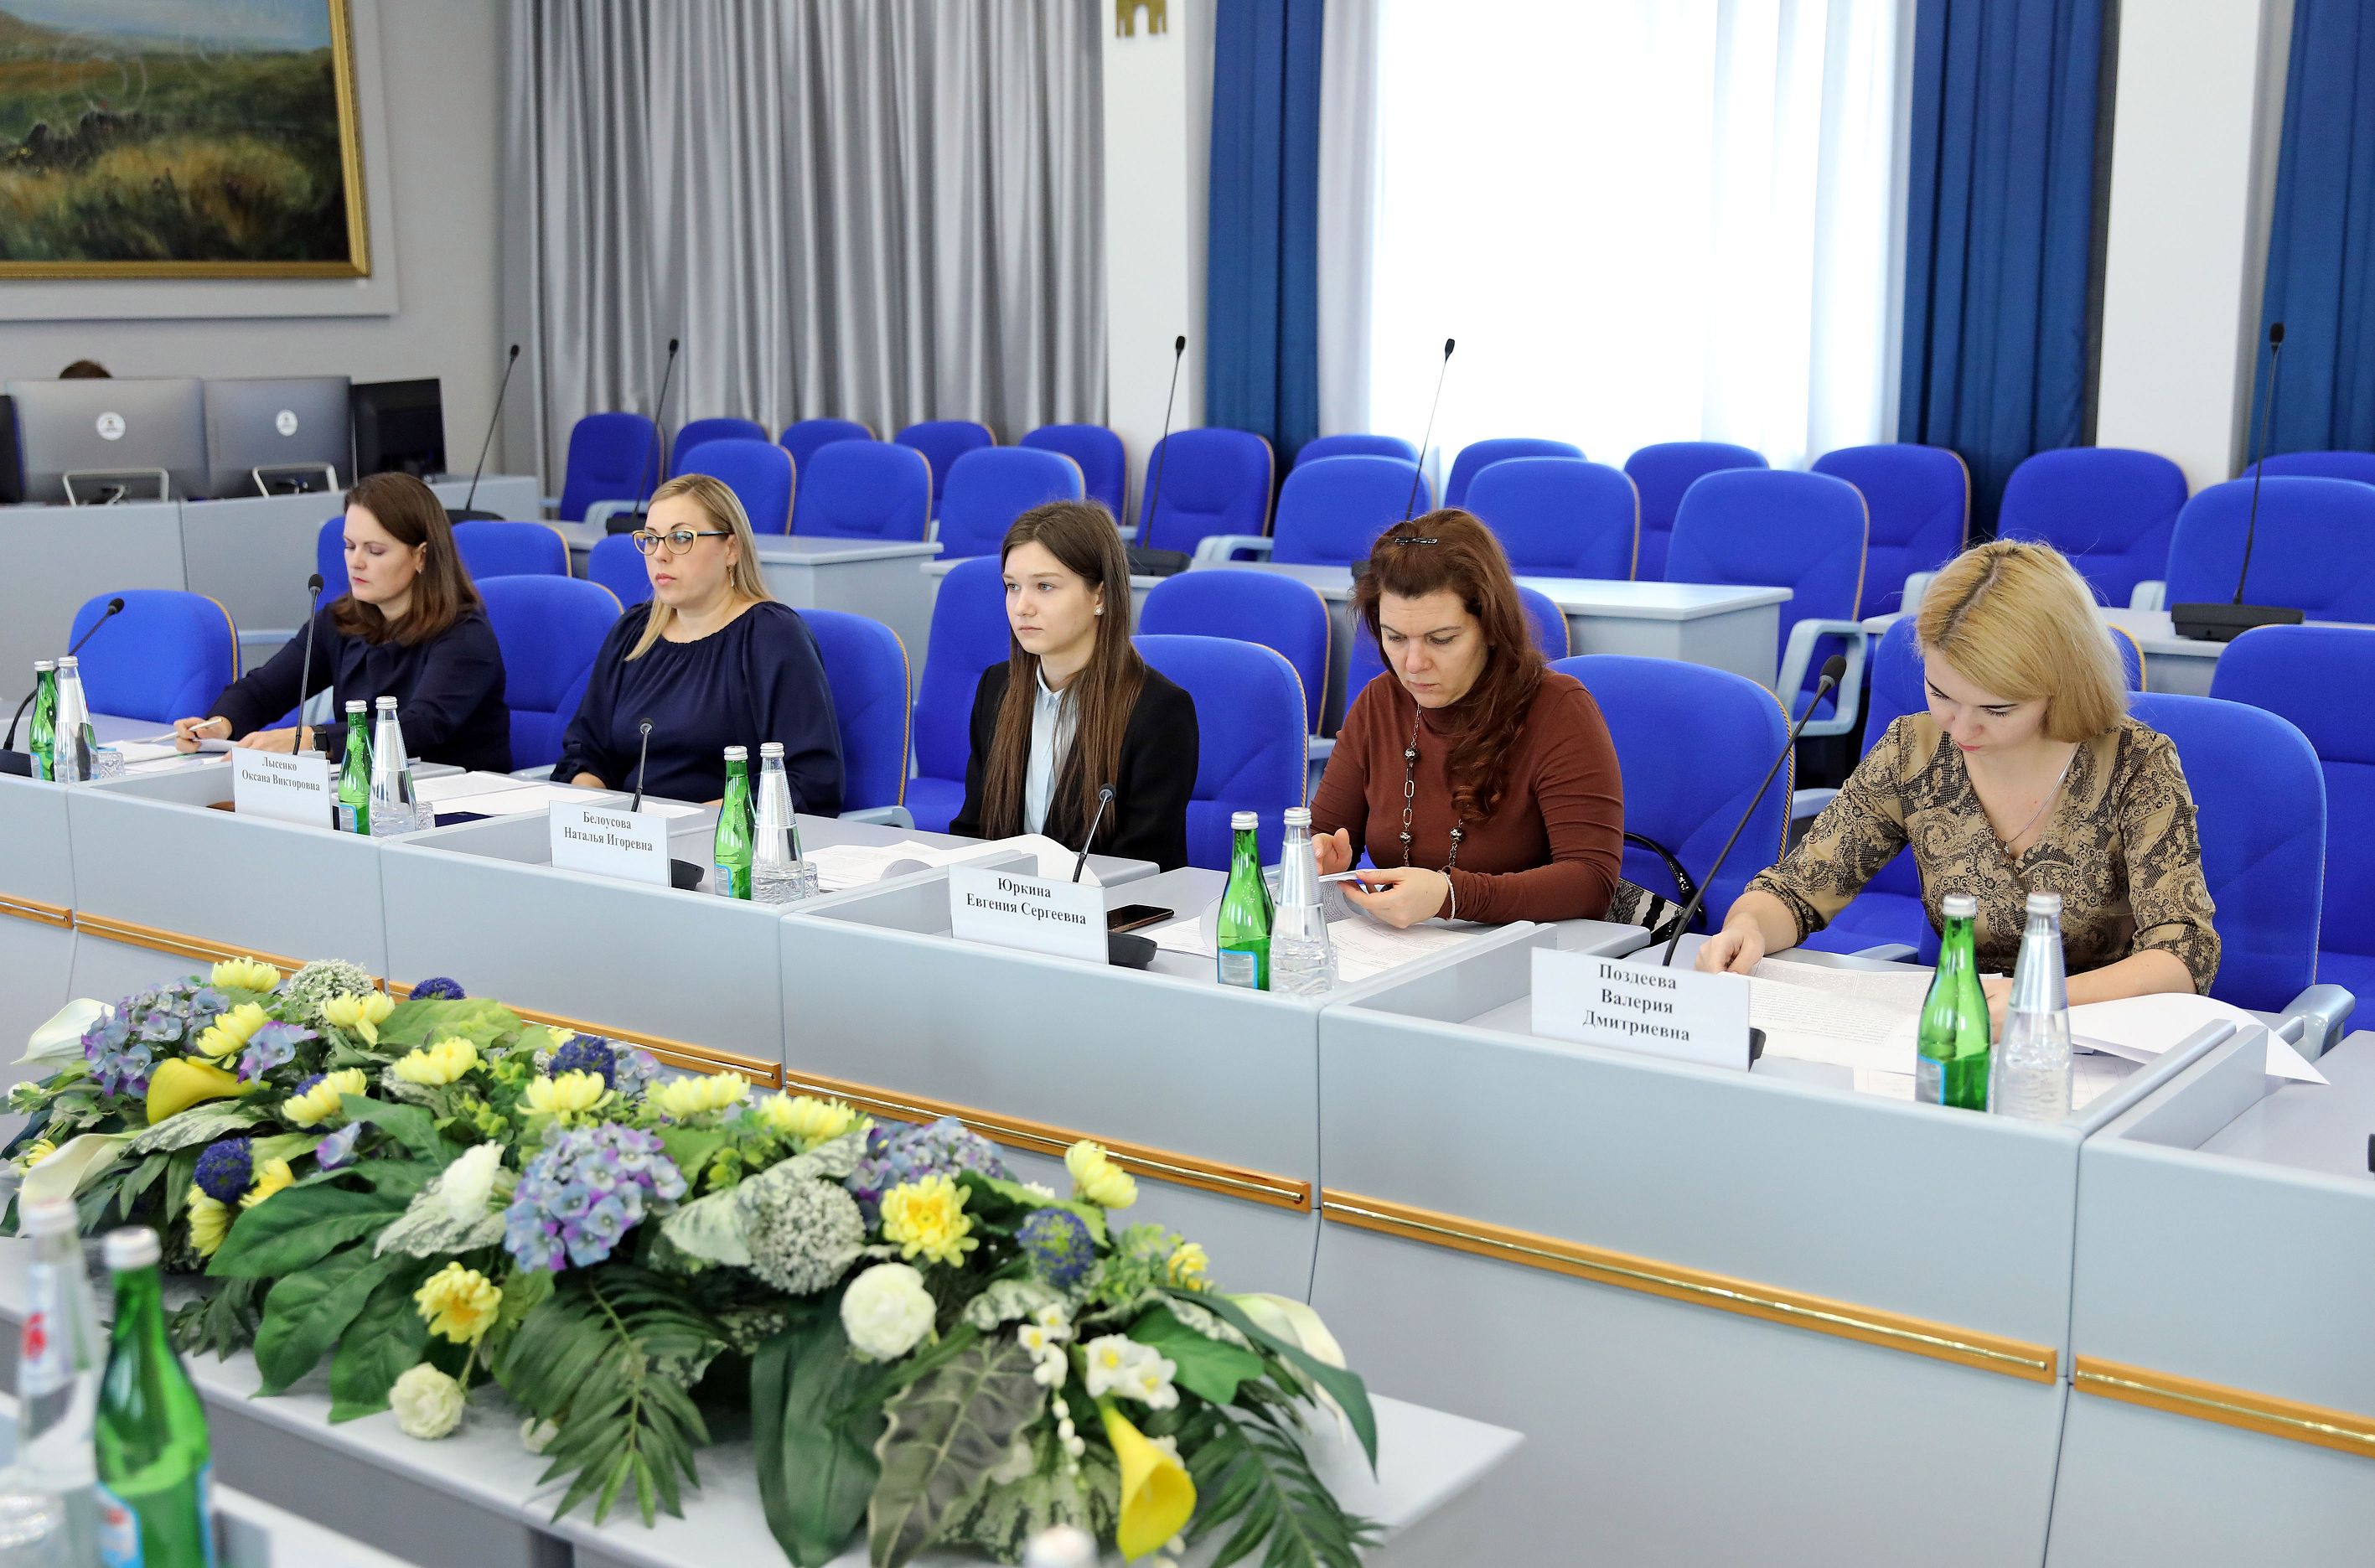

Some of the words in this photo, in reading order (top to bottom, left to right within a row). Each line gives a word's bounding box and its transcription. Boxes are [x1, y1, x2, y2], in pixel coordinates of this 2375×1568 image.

[262, 757, 297, 771] Лысенко
[242, 769, 271, 783] Оксана
[272, 774, 320, 791] Викторовна
[582, 811, 631, 829] Белоусова
[564, 826, 604, 843] Наталья
[607, 833, 653, 851] Игоревна
[998, 877, 1051, 898] Юркина
[966, 893, 1017, 913] Евгения
[1021, 902, 1086, 924] Сергеевна
[1599, 964, 1676, 990] Поздеева
[1601, 988, 1673, 1014] Валерия
[1582, 1010, 1689, 1041] Дмитриевна
